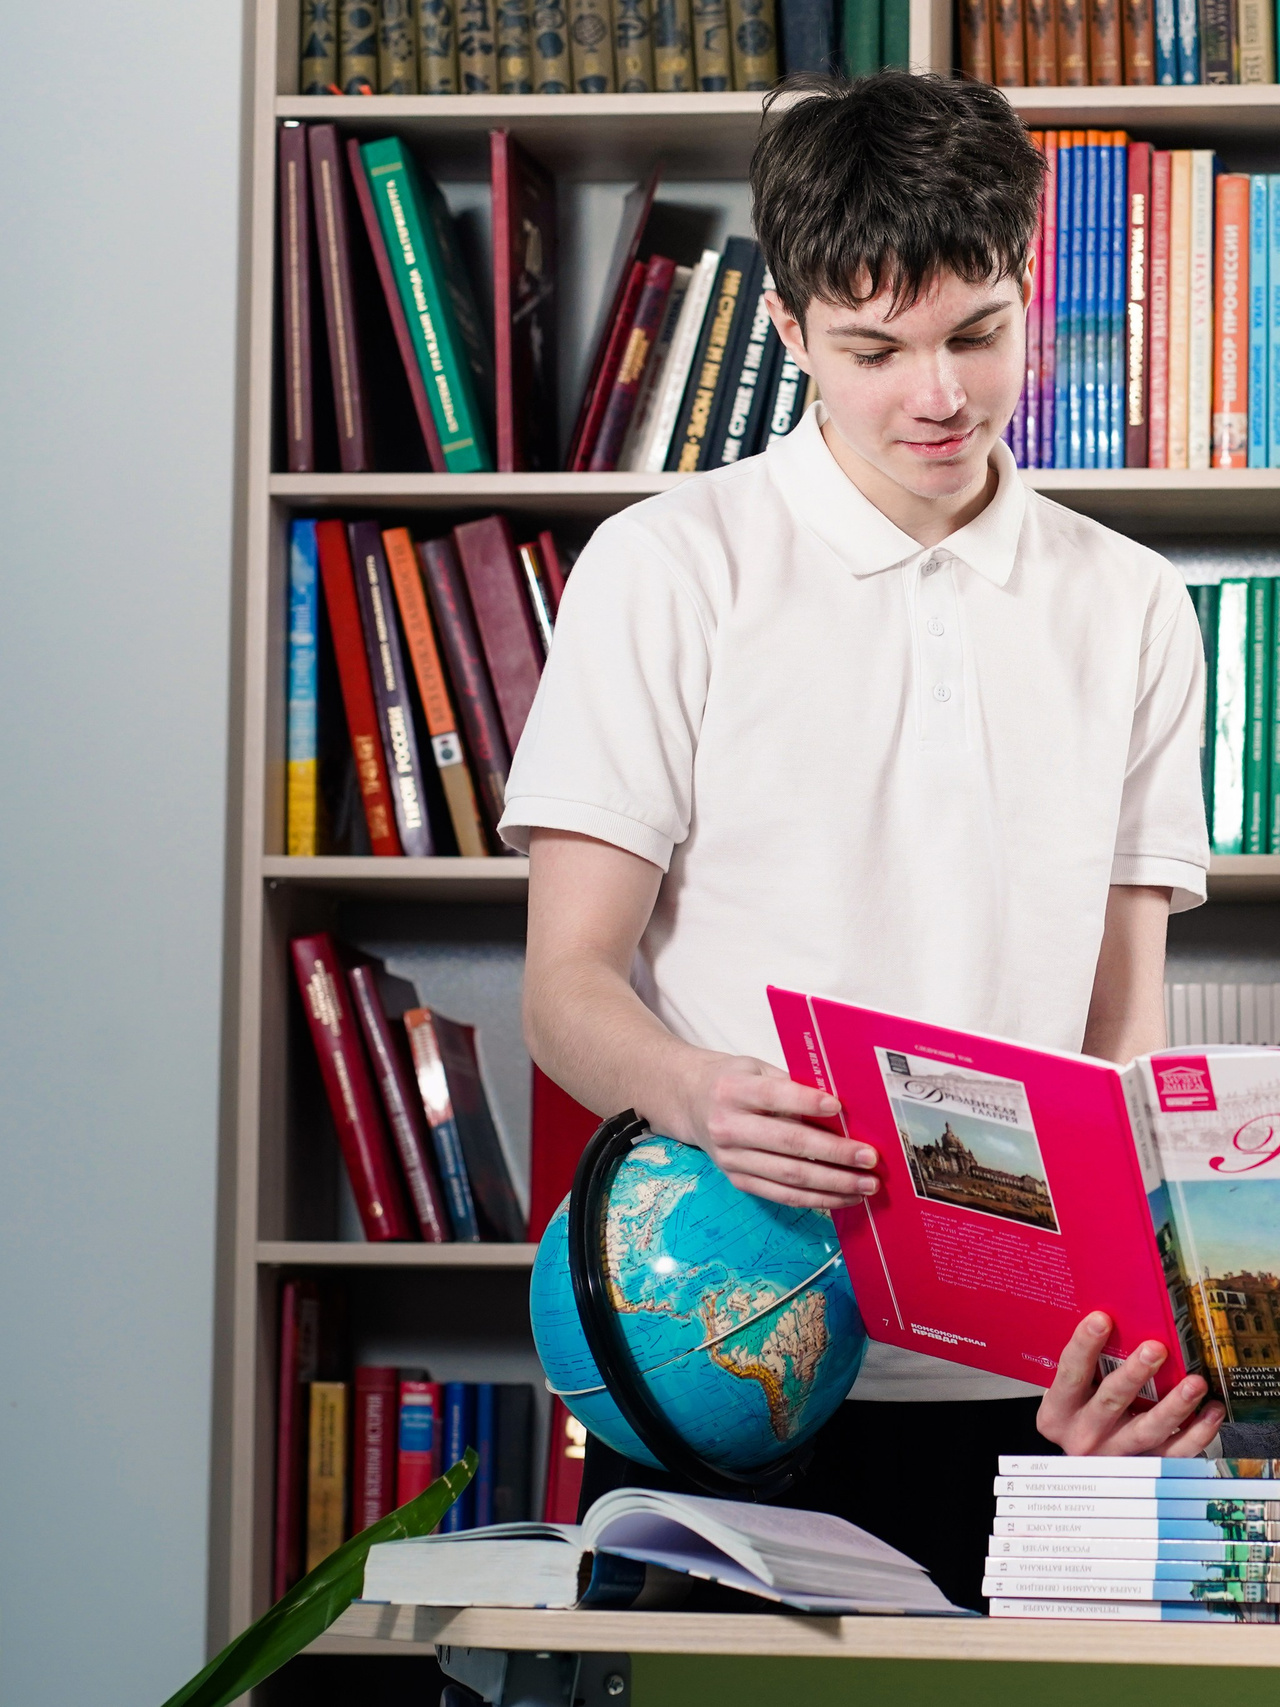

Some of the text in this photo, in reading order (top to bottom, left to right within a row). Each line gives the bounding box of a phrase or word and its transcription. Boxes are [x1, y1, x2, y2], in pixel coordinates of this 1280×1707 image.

[407, 266, 429, 312] ГОРОДА
[1219, 224, 1241, 401] ВЫБОР ПРОФЕССИИ
[385, 705, 413, 774] РОССИИ
[802, 1029, 815, 1051] МИРА
[807, 1050, 822, 1077] МУЗЕИ
[972, 1107, 1018, 1124] ГАЛЕРЕЯ
[882, 1318, 890, 1326] 7
[911, 1323, 987, 1347] КОМСОМОЛЬСКАЯ
[912, 1328, 958, 1345] ПРАВДА
[1007, 1481, 1014, 1491] 28
[1027, 1504, 1062, 1512] УФФИЦИ
[1008, 1523, 1014, 1532] 12
[1055, 1524, 1081, 1532] МУЗЕЙ
[1004, 1543, 1010, 1552] 10
[1052, 1545, 1090, 1553] РУССКИЙ
[1001, 1563, 1008, 1571] 13
[996, 1582, 1003, 1591] 14
[1016, 1584, 1060, 1593] (ВЕНЕЦИЯ)
[1062, 1585, 1108, 1593] АКАДЕМИИ
[1023, 1604, 1119, 1613] ТРЕТЬЯКОВСКАЯ ГАЛЕРЕЯ
